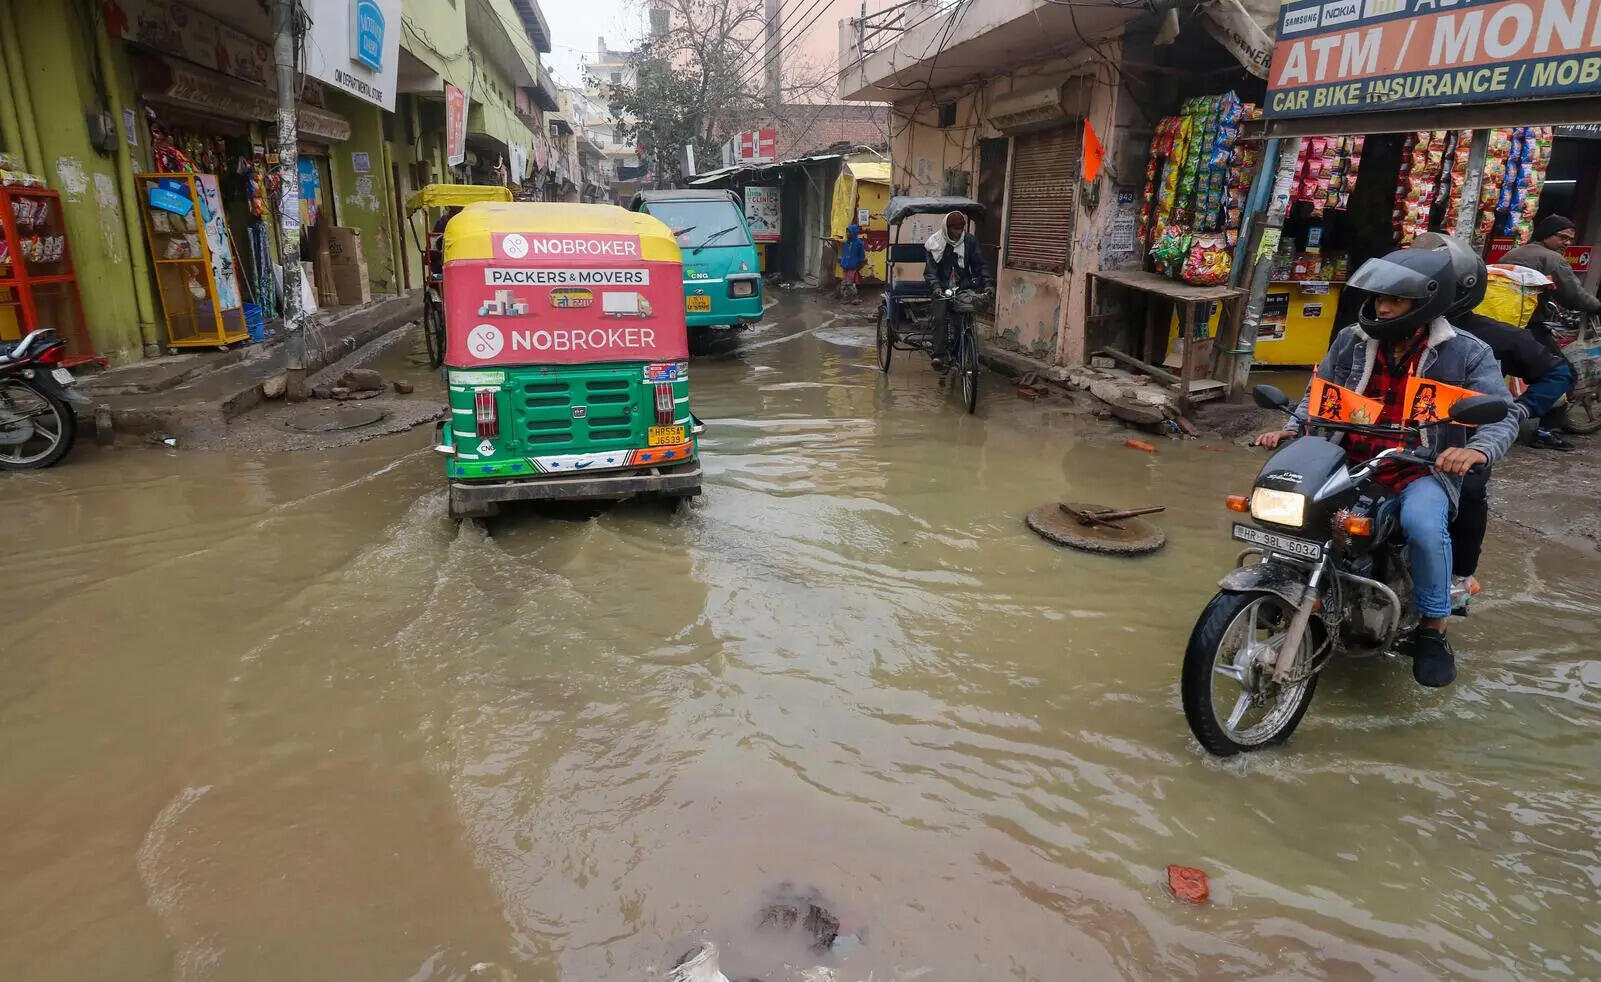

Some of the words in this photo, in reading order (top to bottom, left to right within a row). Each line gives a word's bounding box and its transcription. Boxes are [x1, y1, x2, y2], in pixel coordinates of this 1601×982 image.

[1284, 13, 1318, 27] SAMSUNG
[1325, 5, 1356, 19] NOKIA
[1277, 27, 1384, 86] ATM
[1394, 20, 1416, 71] /
[1428, 0, 1601, 66] MON
[1272, 90, 1307, 111] CAR
[1313, 84, 1360, 109] BIKE
[1366, 66, 1509, 103] INSURANCE
[1514, 64, 1527, 89] /
[1530, 57, 1601, 87] MOB
[533, 238, 636, 256] NOBROKER
[492, 270, 567, 284] PACKERS
[569, 274, 577, 282] &
[578, 270, 643, 284] MOVERS
[511, 327, 656, 351] NOBROKER
[655, 427, 680, 436] HR55A
[655, 435, 681, 444] J6539
[1244, 529, 1256, 540] HR
[1264, 534, 1281, 548] 98L
[1288, 542, 1317, 556] 6034
